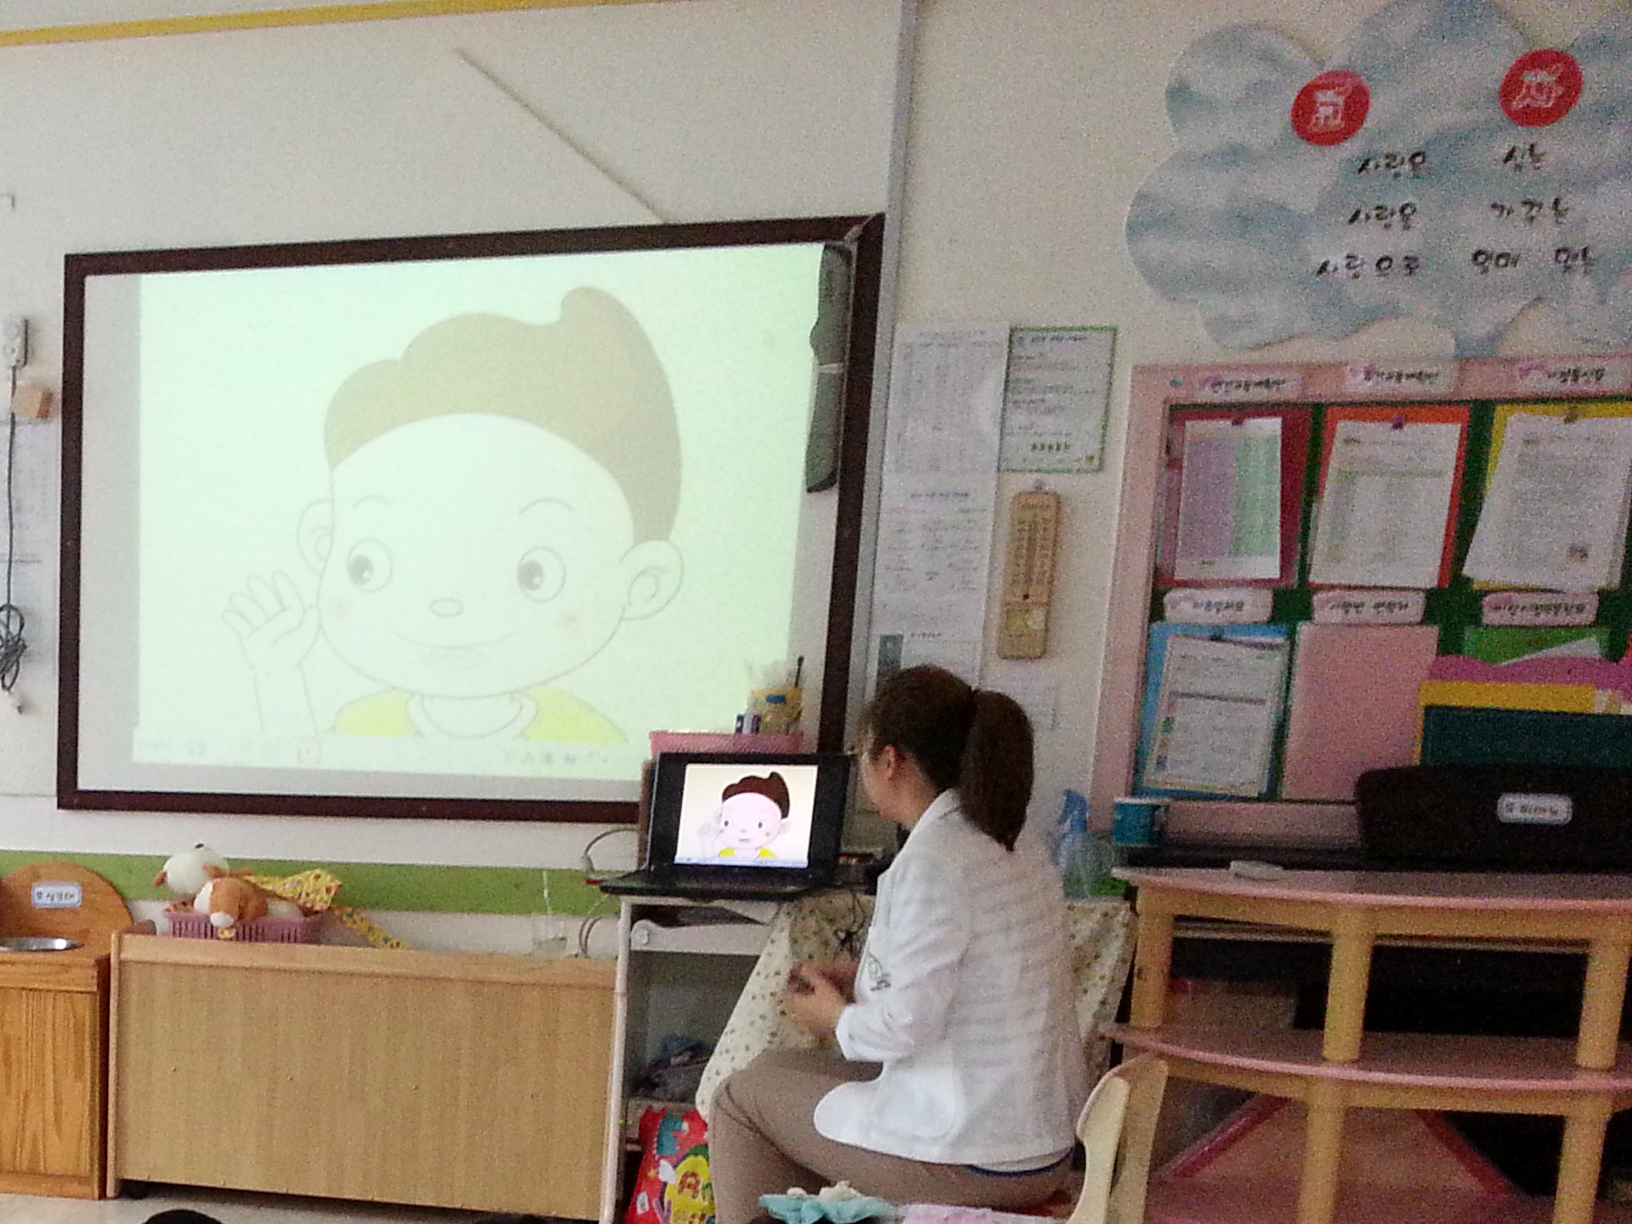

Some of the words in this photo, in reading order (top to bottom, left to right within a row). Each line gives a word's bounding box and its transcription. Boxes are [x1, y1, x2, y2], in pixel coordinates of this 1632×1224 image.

[1356, 150, 1427, 179] 사랑을
[1502, 142, 1547, 171] 심는
[1347, 201, 1418, 230] 사랑을
[1316, 251, 1420, 279] 사랑으로
[1471, 249, 1519, 275] 열매
